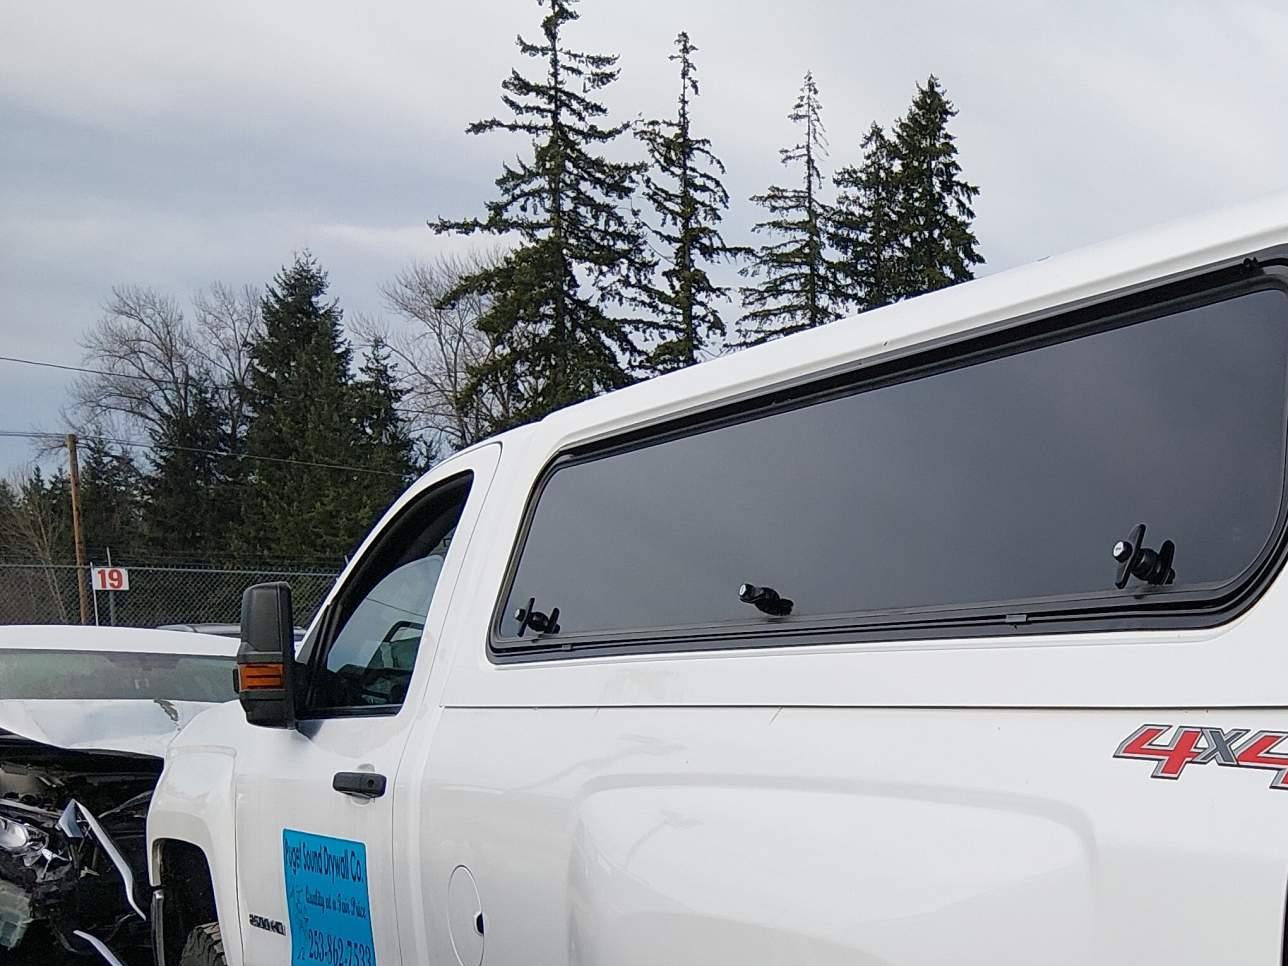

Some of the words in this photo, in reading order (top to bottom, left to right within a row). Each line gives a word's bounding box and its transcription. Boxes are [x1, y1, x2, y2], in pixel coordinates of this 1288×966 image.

[97, 569, 123, 589] 19
[303, 842, 322, 874] Sound
[324, 845, 349, 884] Drywall
[351, 850, 364, 883] Co.
